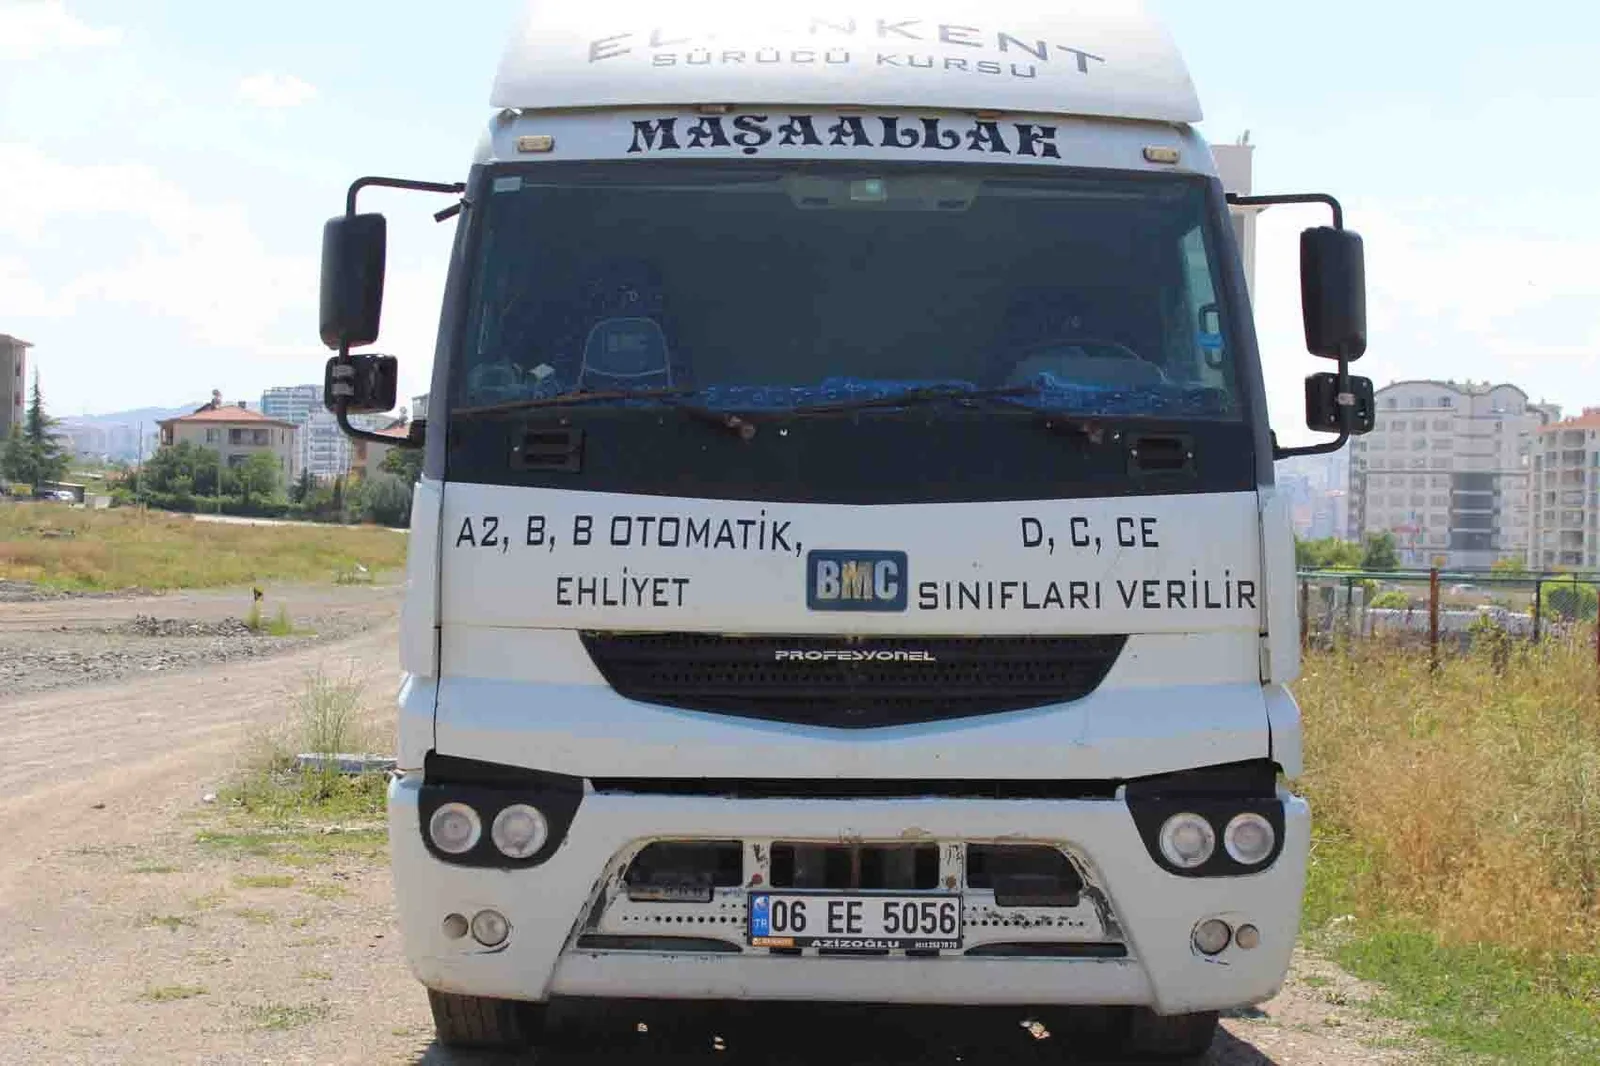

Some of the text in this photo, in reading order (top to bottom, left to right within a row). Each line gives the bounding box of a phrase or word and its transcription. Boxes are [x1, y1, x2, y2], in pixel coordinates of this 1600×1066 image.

[588, 17, 1105, 75] ELNKENT
[652, 47, 1036, 79] SÜRÜCÜ KURSU
[456, 510, 1160, 557] A2, B, B OTOMATİK, D, C, CE
[556, 567, 1256, 611] EHLİYET SINIFLARI VERİLİR
[814, 560, 899, 601] BMC
[775, 650, 936, 662] PROFESYONEL
[753, 918, 767, 927] TR
[772, 900, 956, 934] 06 EE 5056
